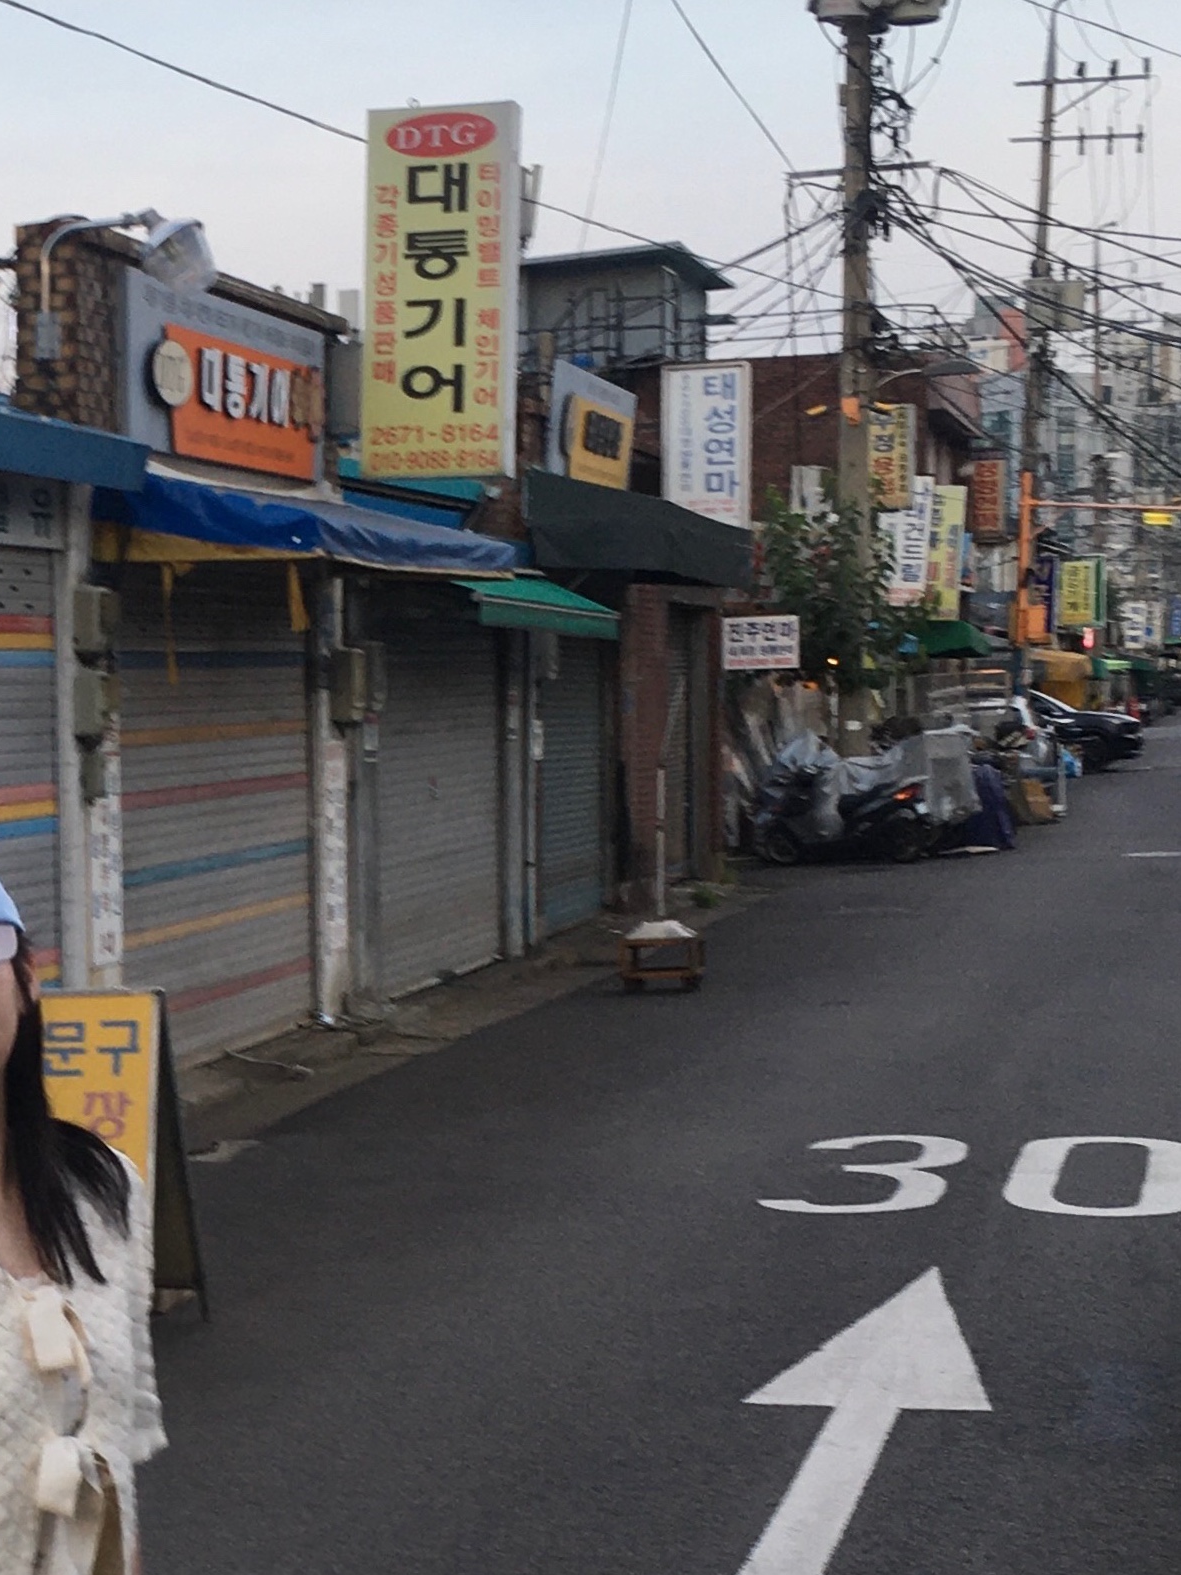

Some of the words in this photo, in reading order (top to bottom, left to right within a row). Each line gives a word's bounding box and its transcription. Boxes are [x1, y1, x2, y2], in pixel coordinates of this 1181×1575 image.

[397, 121, 478, 150] DTG
[41, 1019, 140, 1077] 문구
[756, 1134, 1181, 1217] 30
